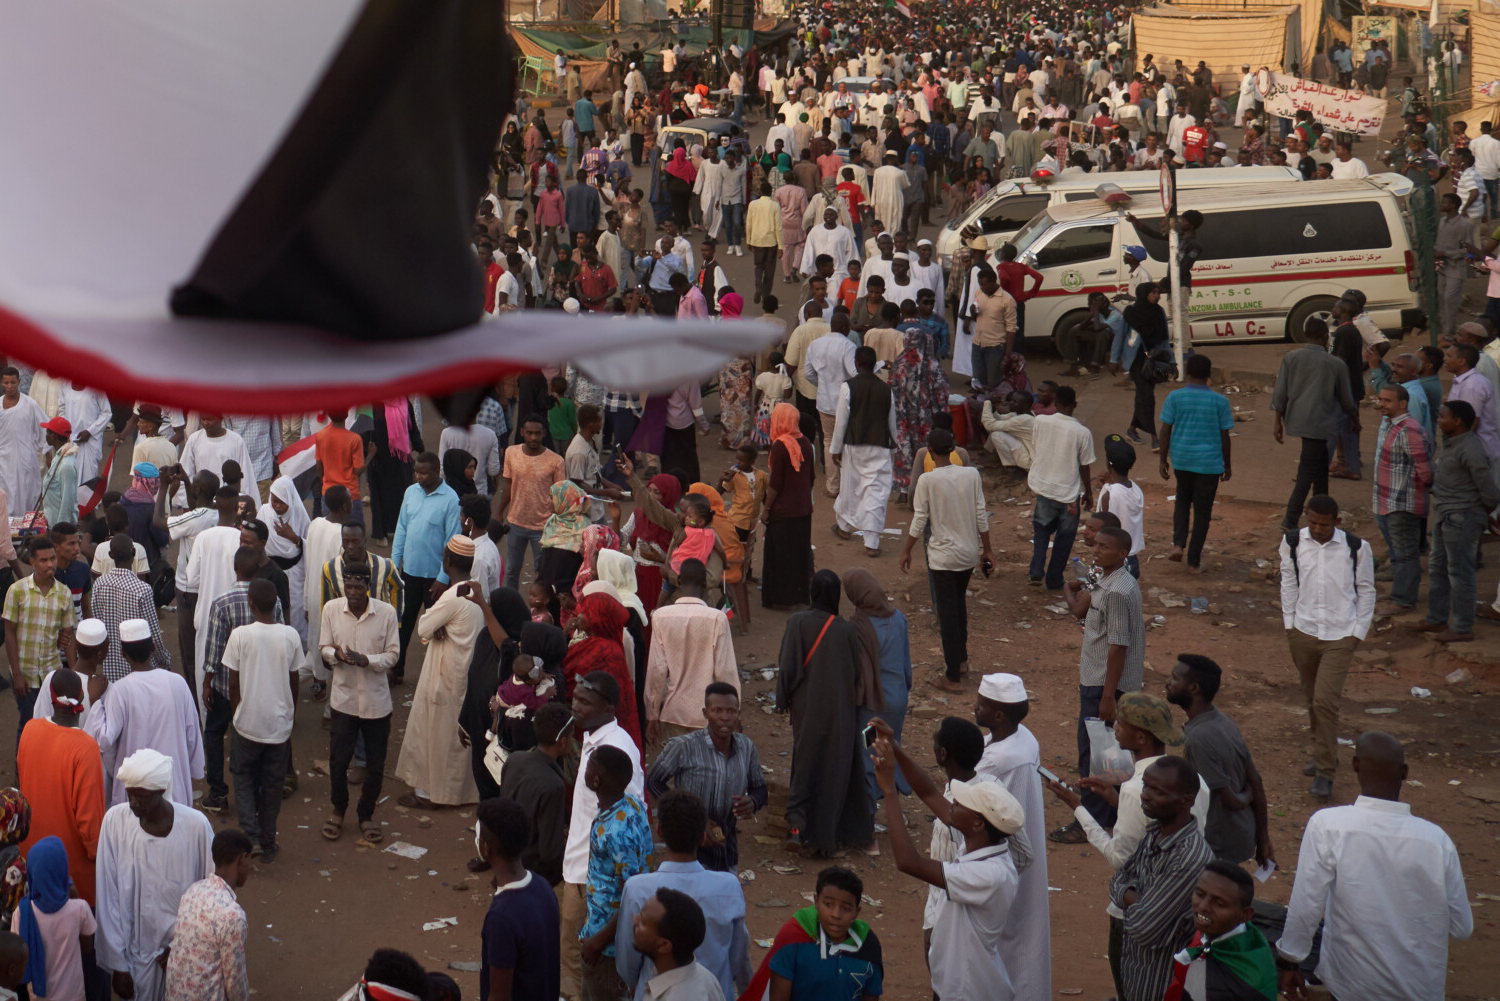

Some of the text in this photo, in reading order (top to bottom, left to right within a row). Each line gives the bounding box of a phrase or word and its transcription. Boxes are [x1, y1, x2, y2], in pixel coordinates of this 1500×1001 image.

[1314, 256, 1338, 264] لخدمات
[1365, 253, 1382, 262] مركز
[1296, 258, 1313, 267] النقل
[1218, 300, 1263, 312] AMBULANCE
[1214, 321, 1235, 337] LA
